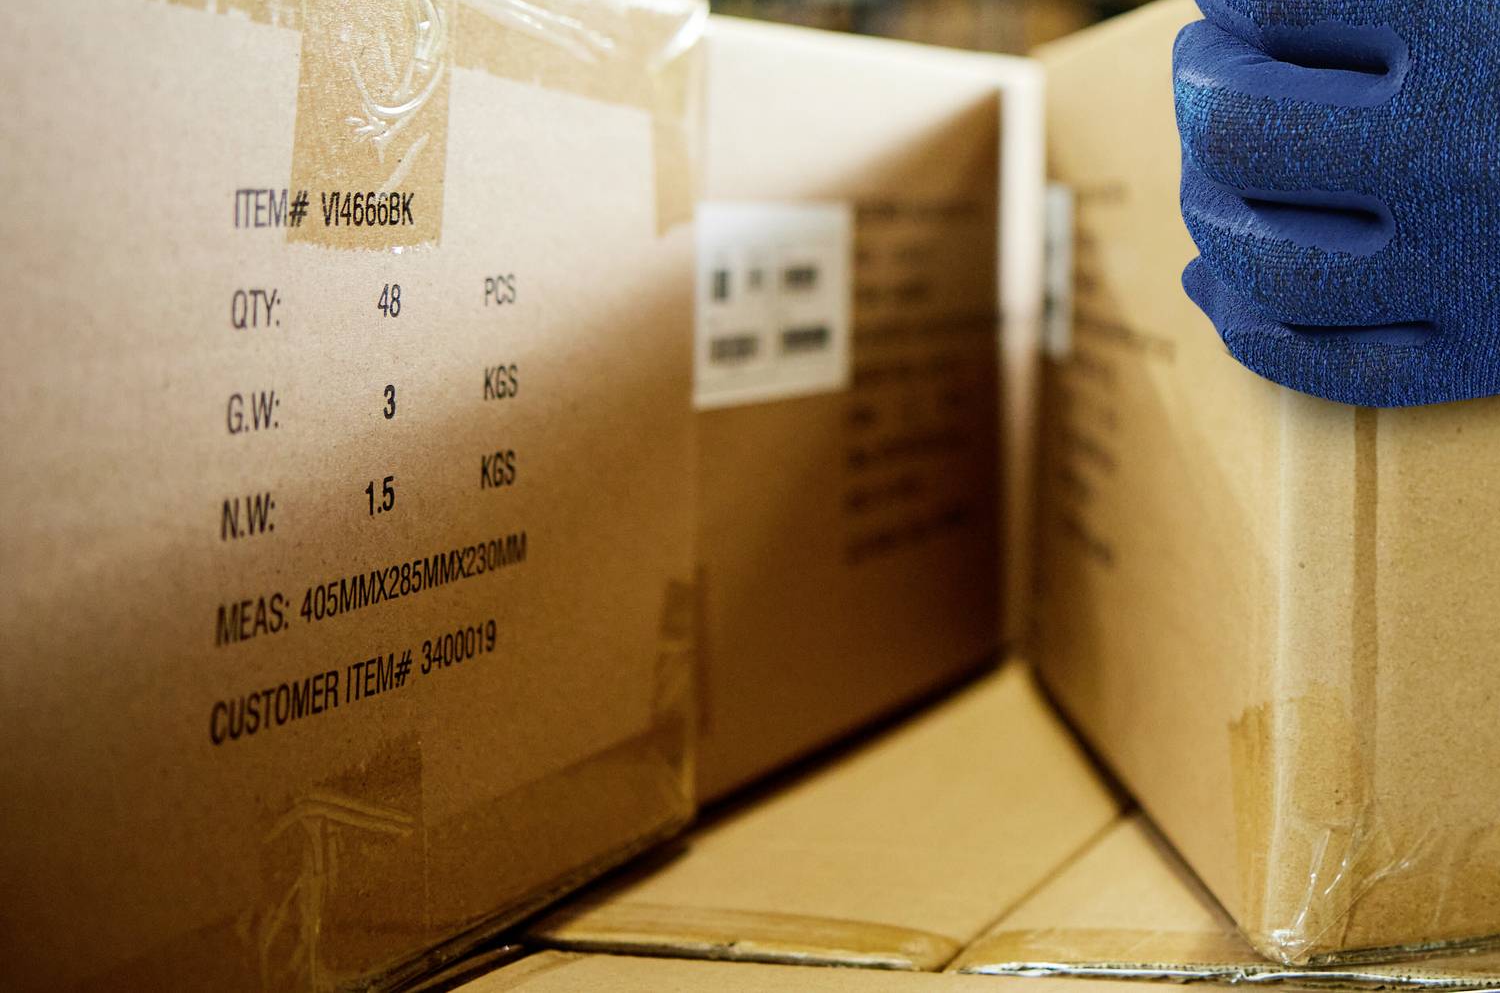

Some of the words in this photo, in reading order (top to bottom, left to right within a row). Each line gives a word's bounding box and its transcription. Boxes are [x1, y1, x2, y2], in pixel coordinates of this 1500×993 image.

[234, 190, 308, 229] ITEM#
[322, 191, 414, 227] VI4666BK
[231, 289, 281, 329] QTY:
[378, 284, 401, 319] 48
[485, 275, 515, 307] PCS
[227, 392, 280, 435] G.W:
[383, 384, 396, 420] 3
[484, 365, 518, 401] KGS
[221, 494, 275, 542] N.W:
[366, 476, 395, 516] 1.5
[481, 450, 516, 490] KGS
[216, 598, 289, 647] MEAS:
[300, 531, 526, 624] 405MMX285MMX230MM
[211, 671, 339, 746] CUSTOMER
[346, 650, 413, 704] ITEM#
[421, 619, 497, 676] 3400019
